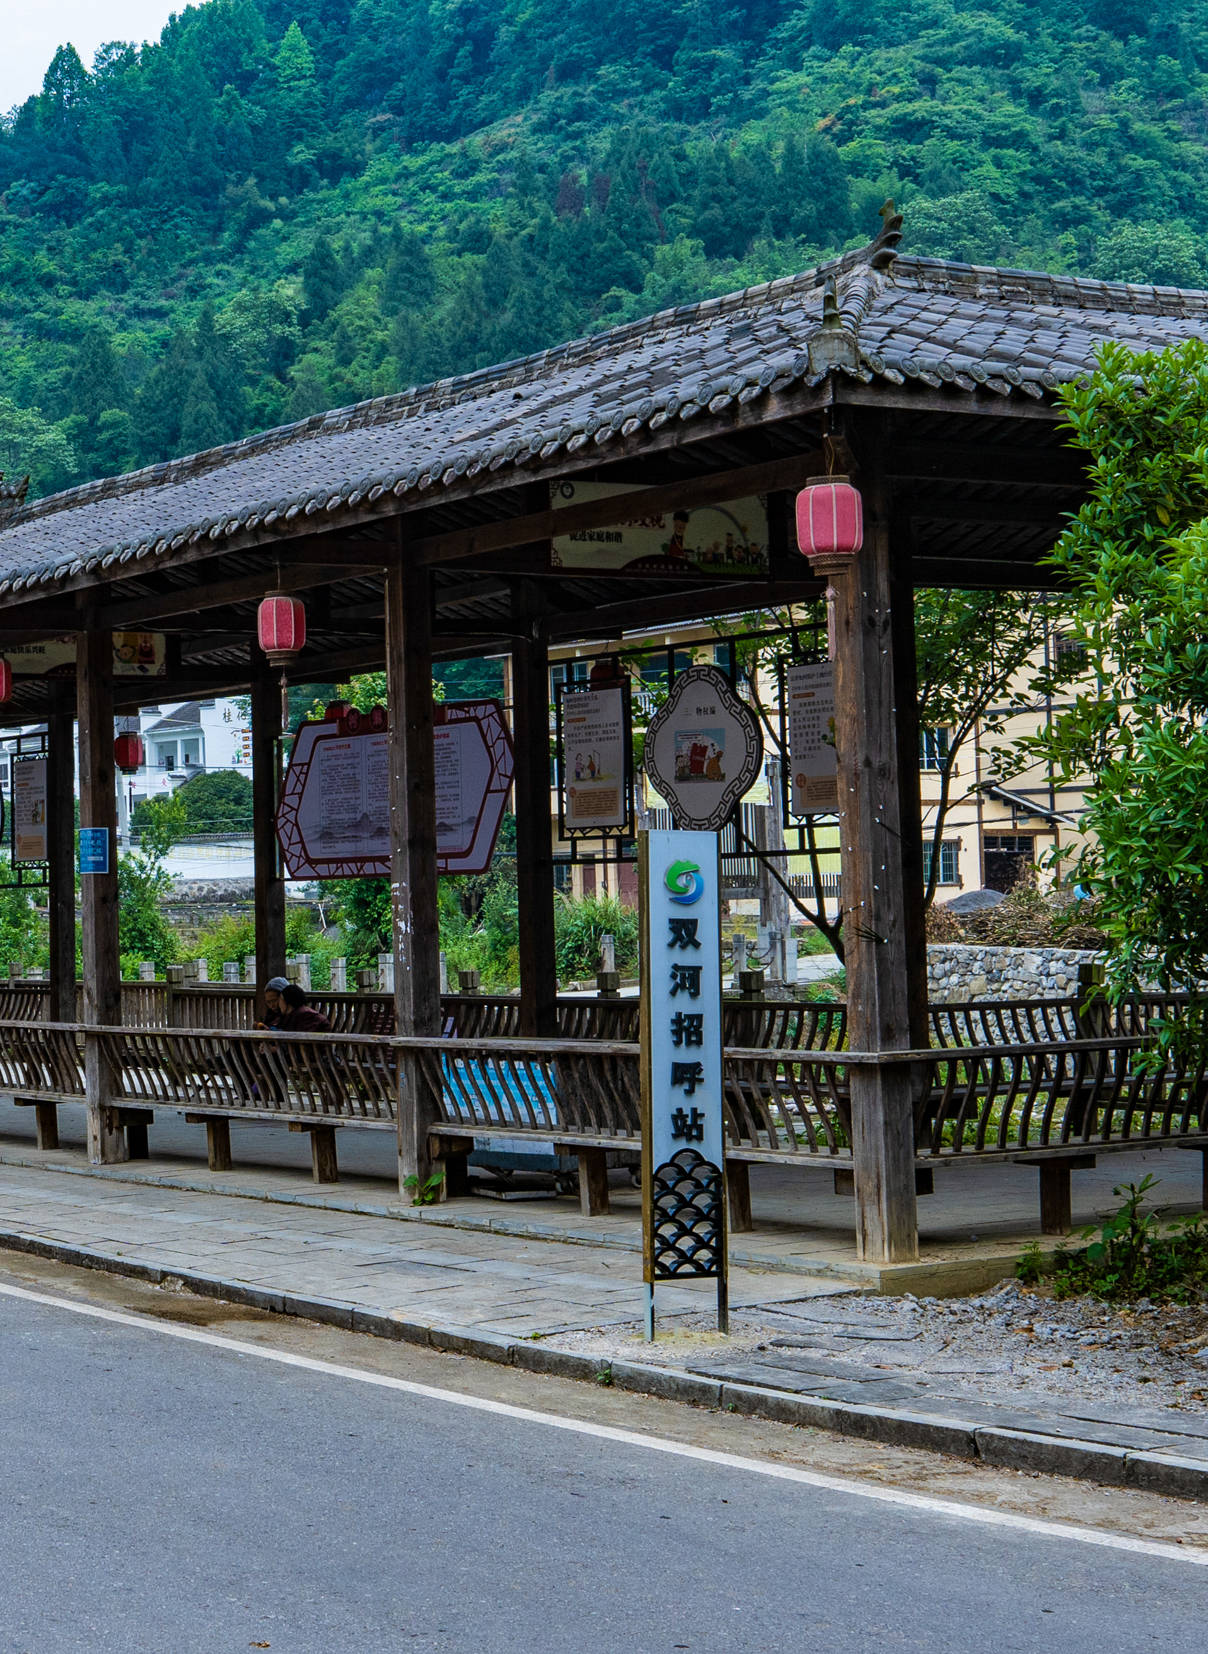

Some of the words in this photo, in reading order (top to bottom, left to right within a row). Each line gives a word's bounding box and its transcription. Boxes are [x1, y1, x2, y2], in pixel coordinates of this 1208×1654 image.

[668, 918, 704, 1142] 双河招呼站
